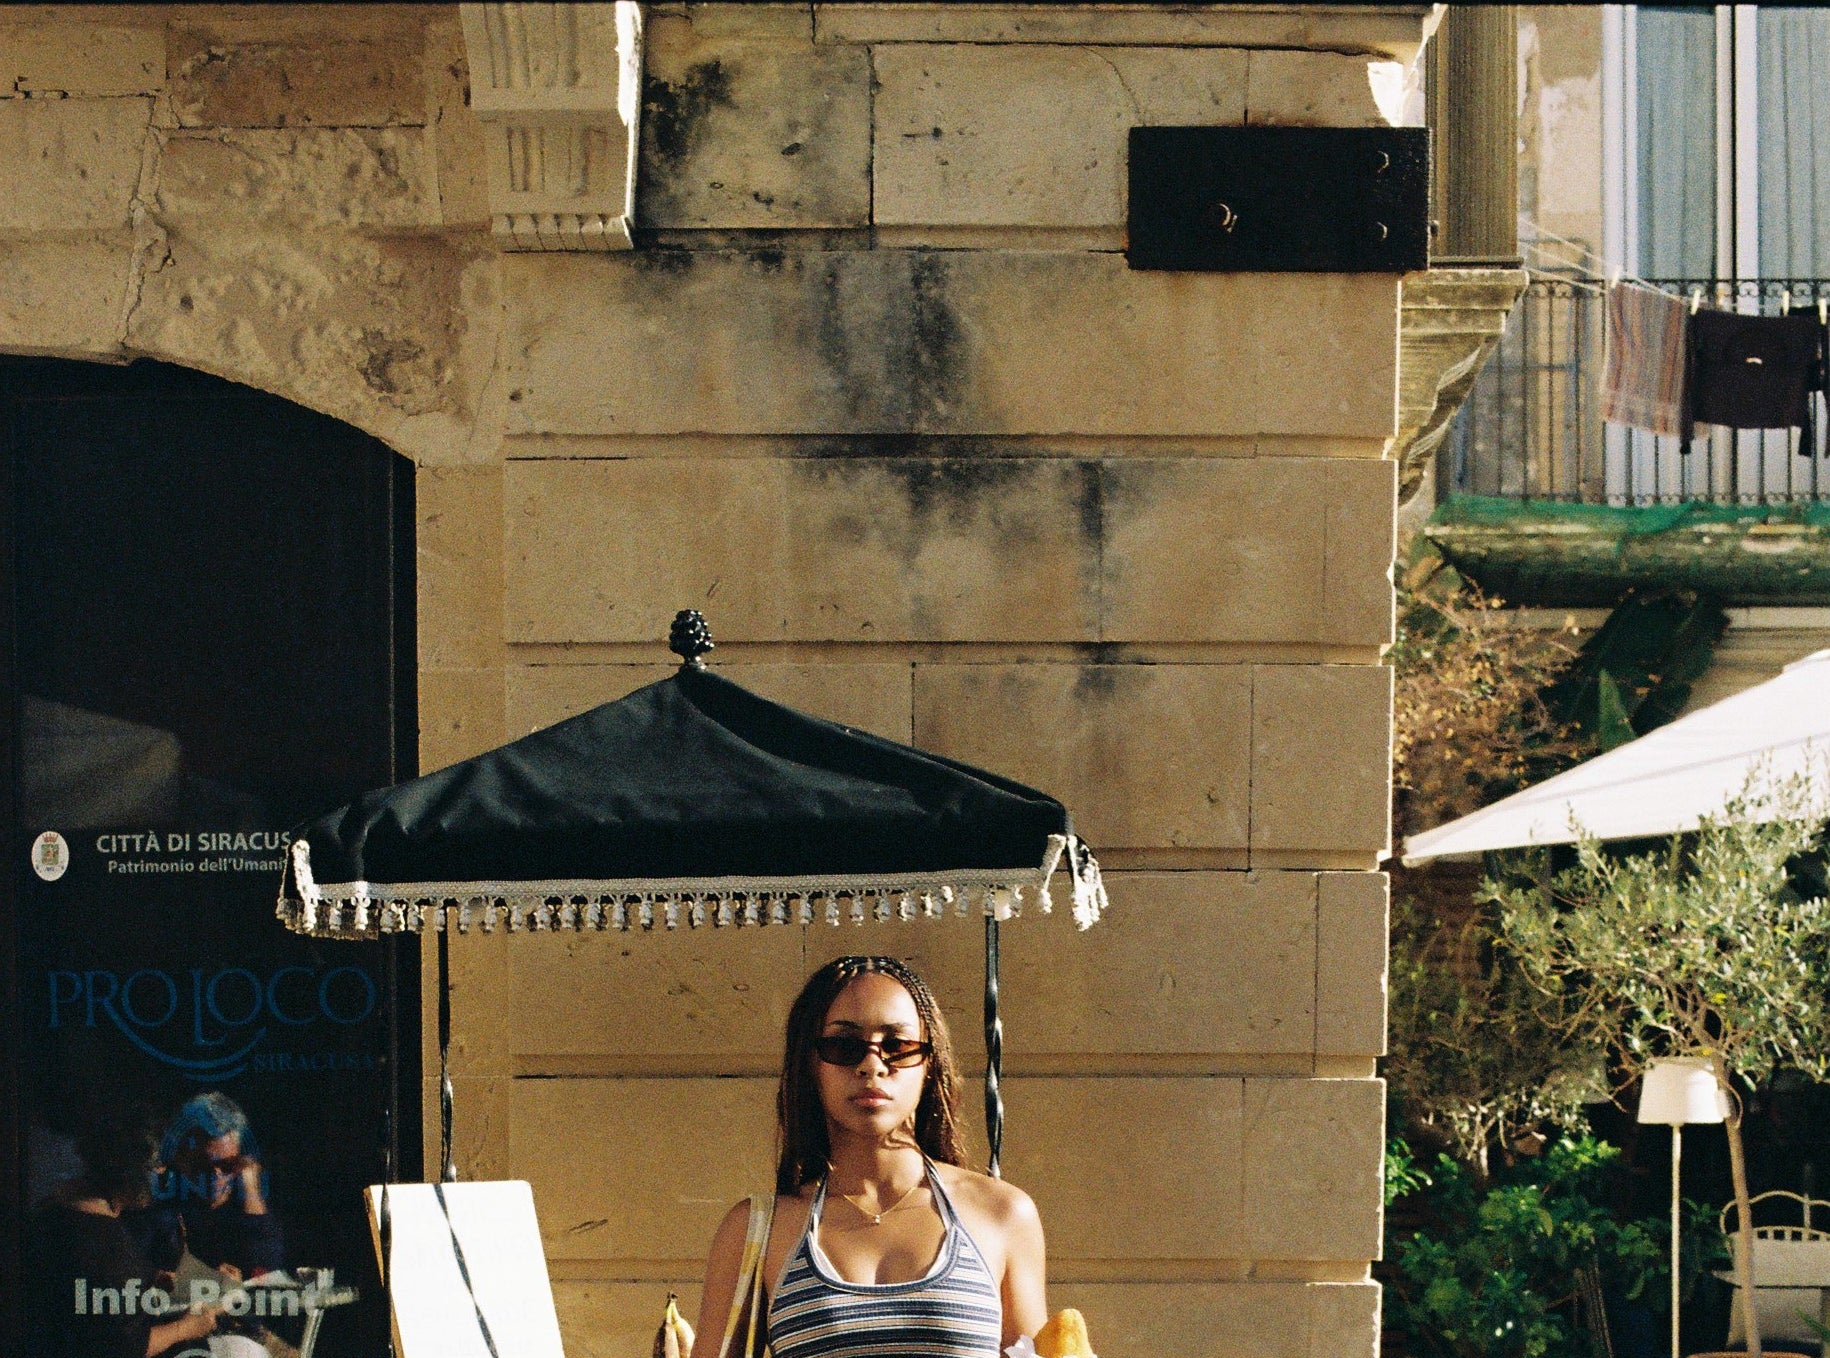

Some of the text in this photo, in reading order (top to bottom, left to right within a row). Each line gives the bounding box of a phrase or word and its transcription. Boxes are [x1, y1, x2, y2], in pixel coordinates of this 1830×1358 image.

[96, 831, 160, 852] CITTÀ
[167, 833, 190, 851] DI
[108, 859, 194, 873] Patrimonio
[75, 1278, 172, 1316] Info
